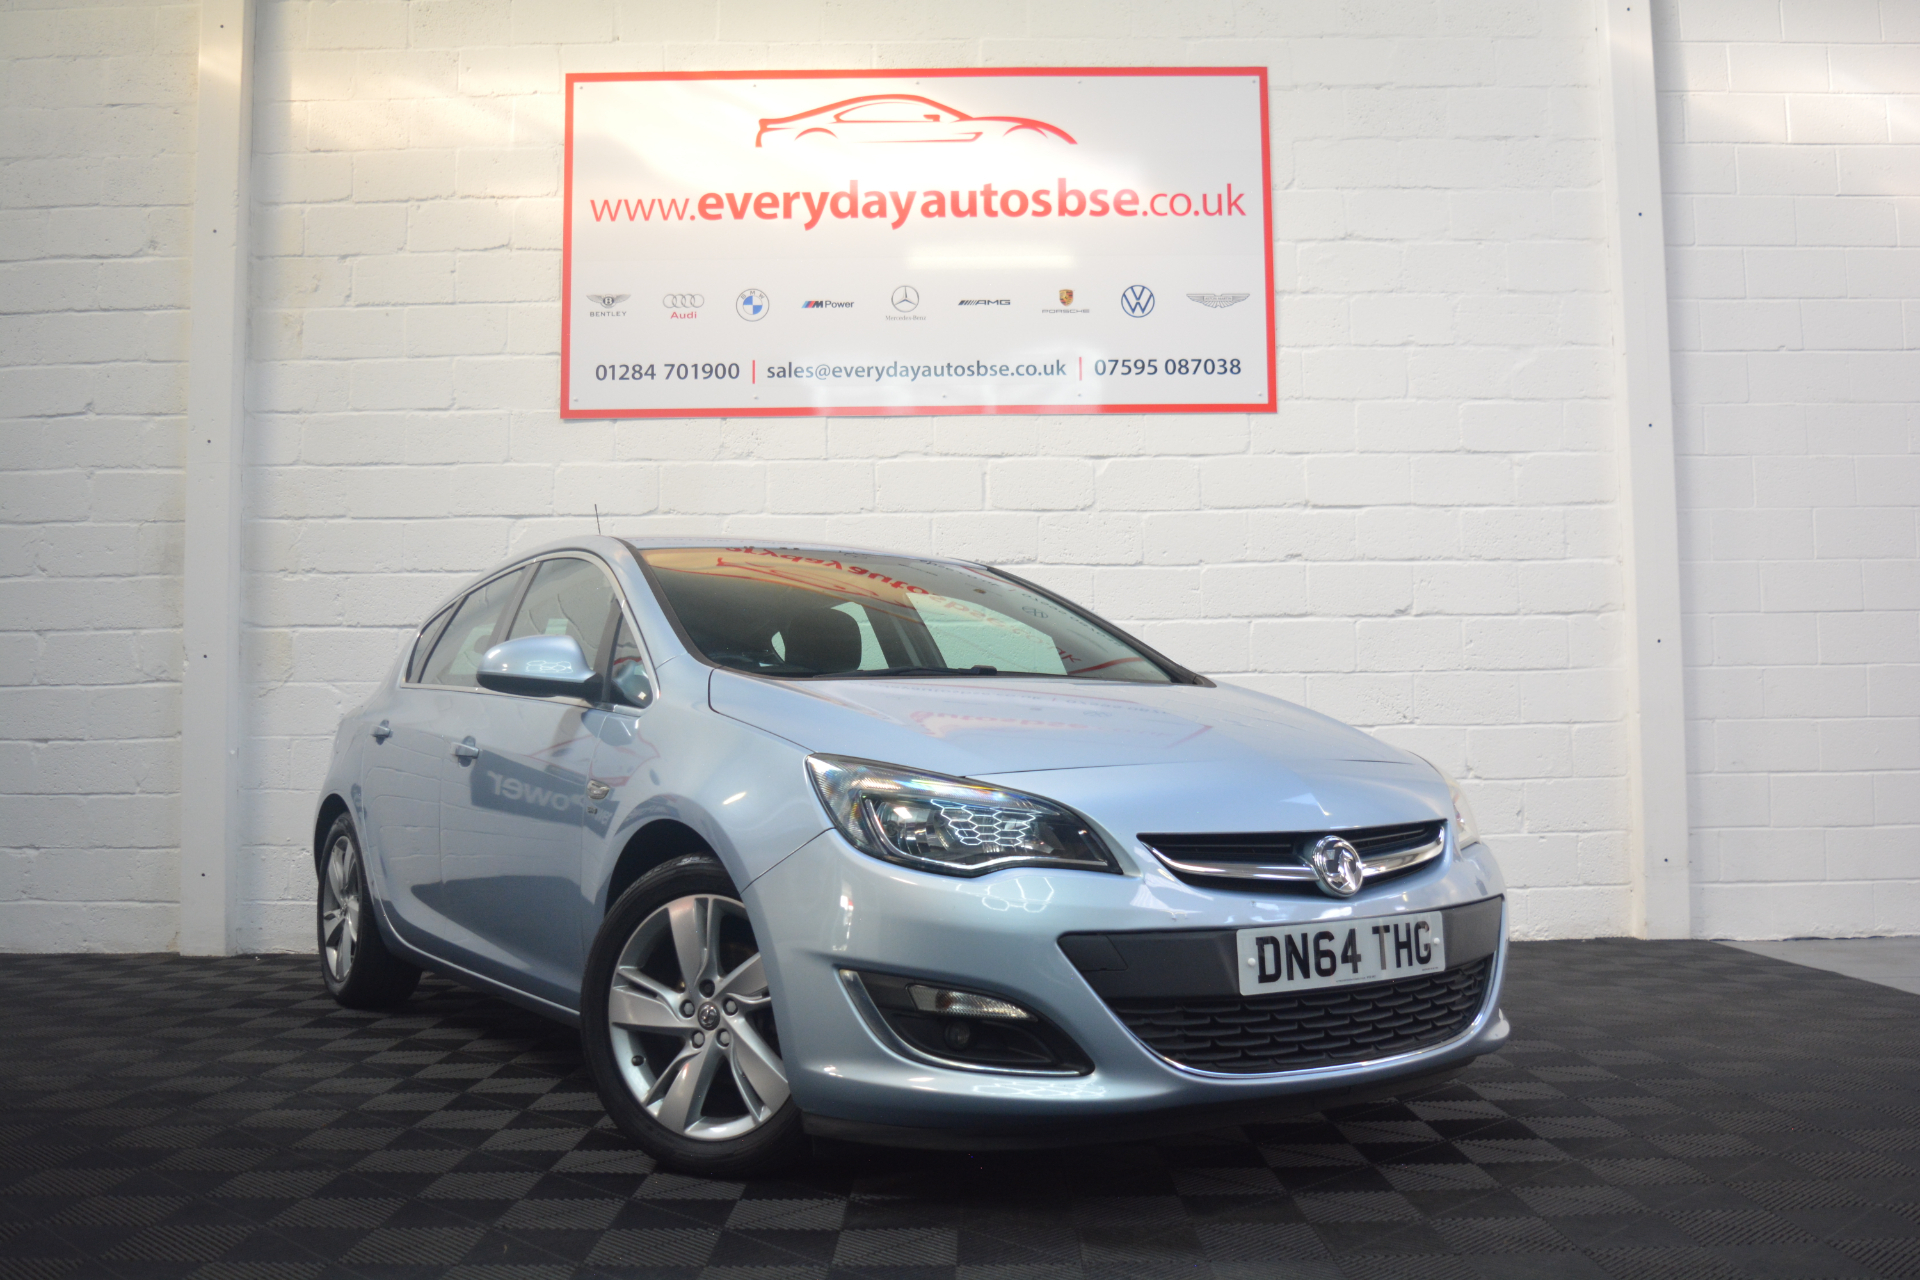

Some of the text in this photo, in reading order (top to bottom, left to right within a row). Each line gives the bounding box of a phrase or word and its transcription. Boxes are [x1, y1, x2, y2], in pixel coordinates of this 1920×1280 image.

[589, 177, 1247, 230] www.everydayautosbse.co.uk
[589, 310, 627, 318] BENTLEY
[670, 311, 697, 320] Audi
[595, 357, 1242, 383] 01284 701900 sales@everydayautosbse.co.uk 07595 087038
[1255, 920, 1432, 983] DN64 THG
